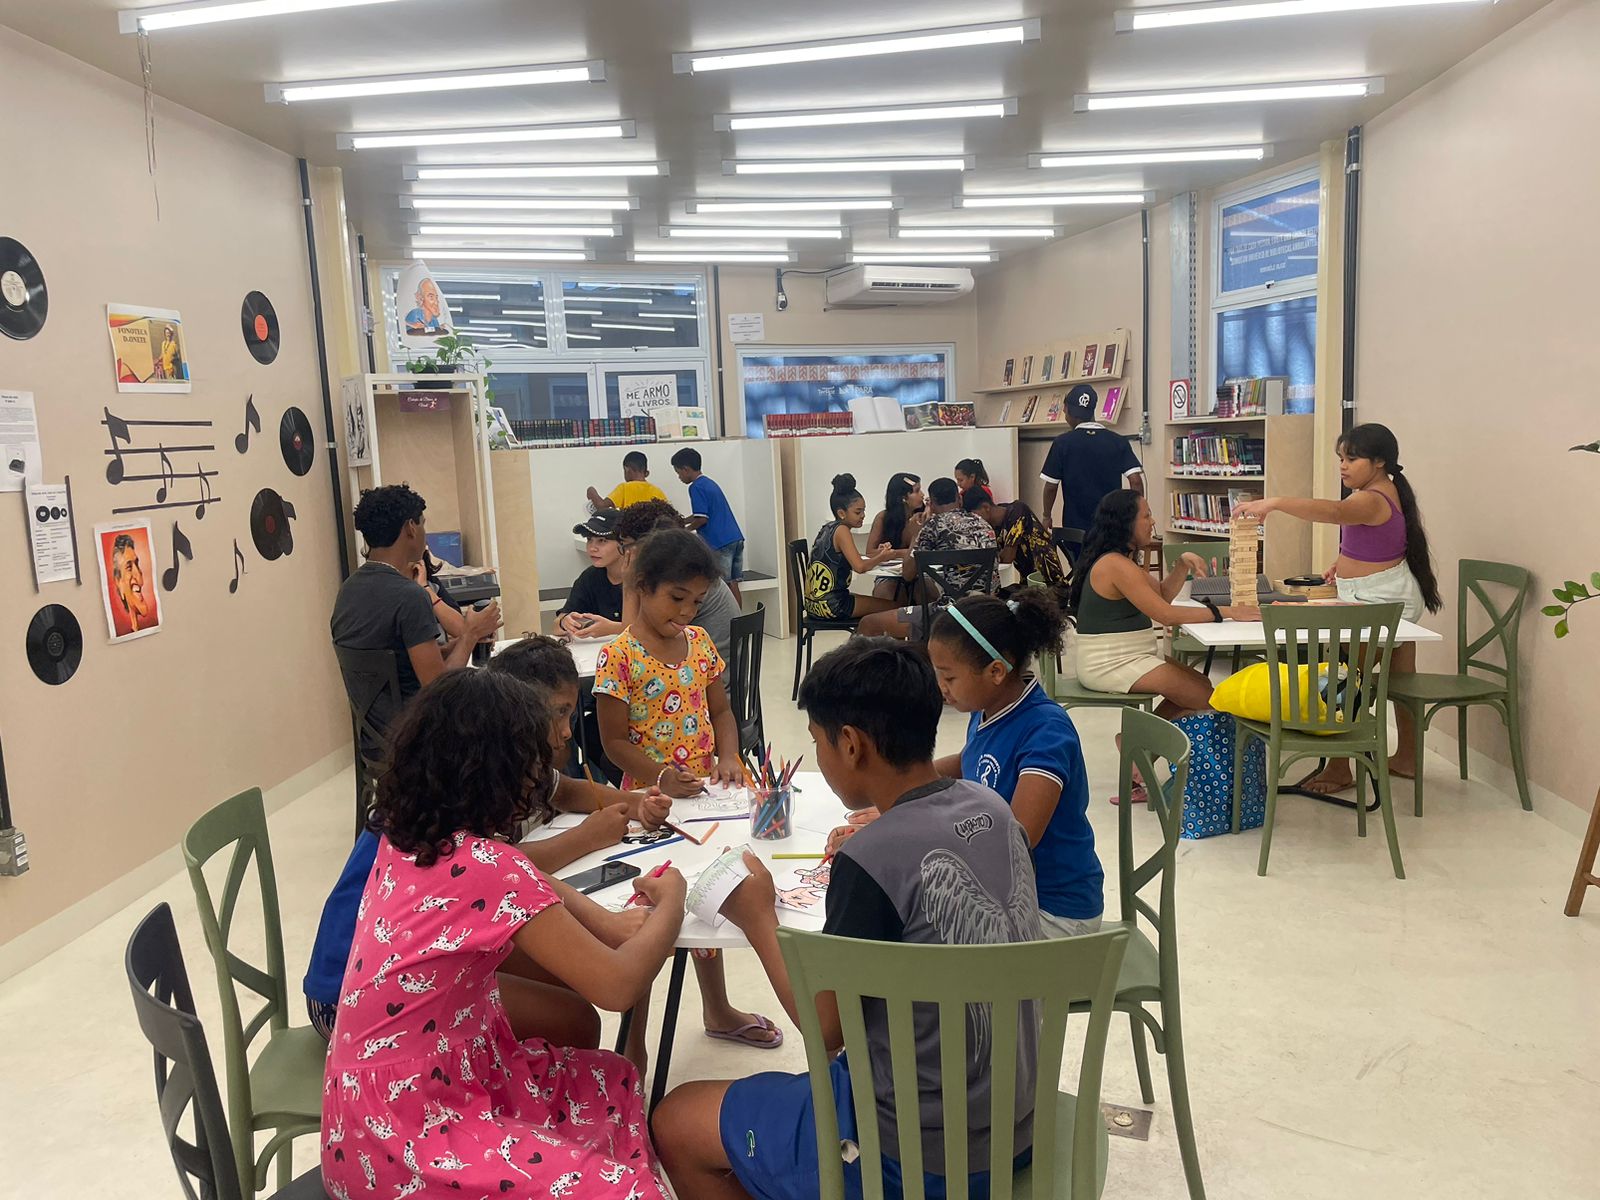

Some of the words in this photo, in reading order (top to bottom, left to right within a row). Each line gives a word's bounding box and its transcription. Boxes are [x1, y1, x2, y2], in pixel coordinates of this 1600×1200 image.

[626, 391, 640, 400] ME
[643, 384, 670, 398] ARMO
[637, 399, 670, 407] LIVROS
